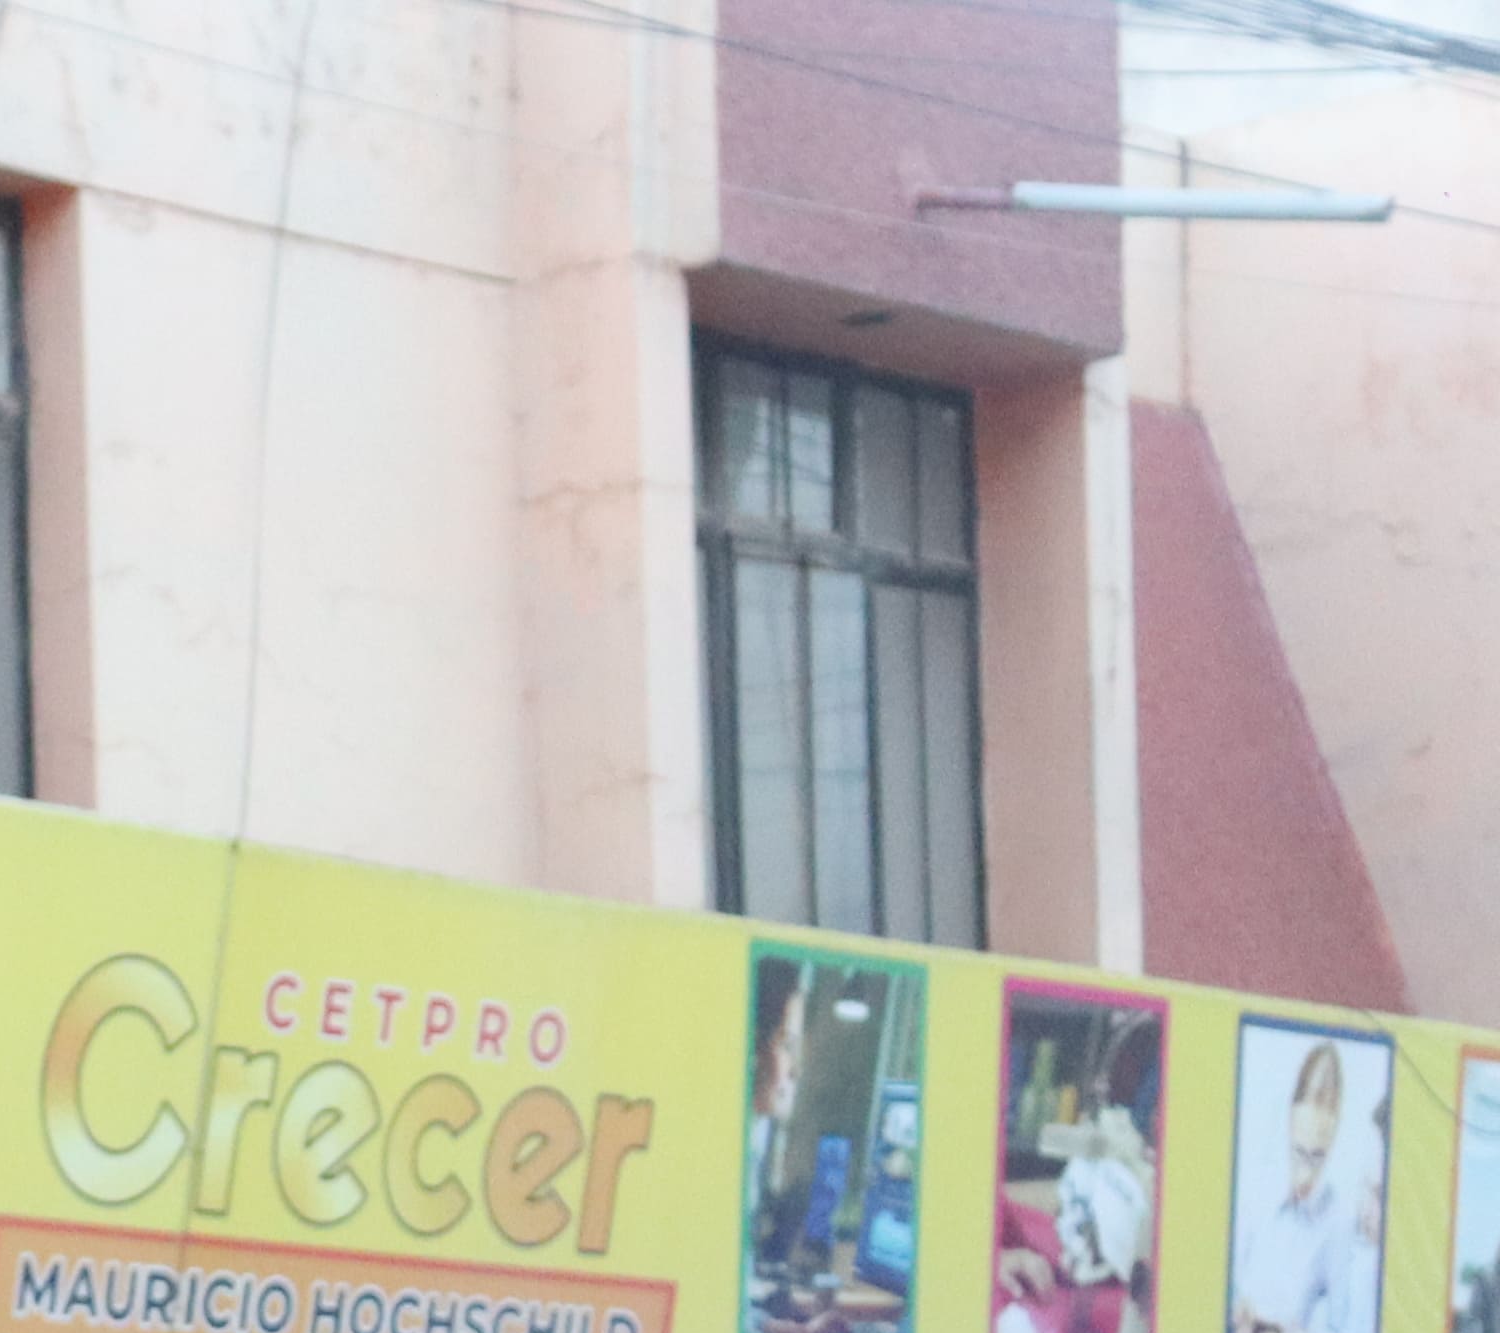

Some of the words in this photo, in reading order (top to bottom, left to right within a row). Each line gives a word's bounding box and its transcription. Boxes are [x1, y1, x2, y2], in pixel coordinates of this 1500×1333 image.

[264, 974, 566, 1065] CETPRO
[39, 952, 654, 1256] Crecer
[14, 1253, 295, 1333] MAURICIO
